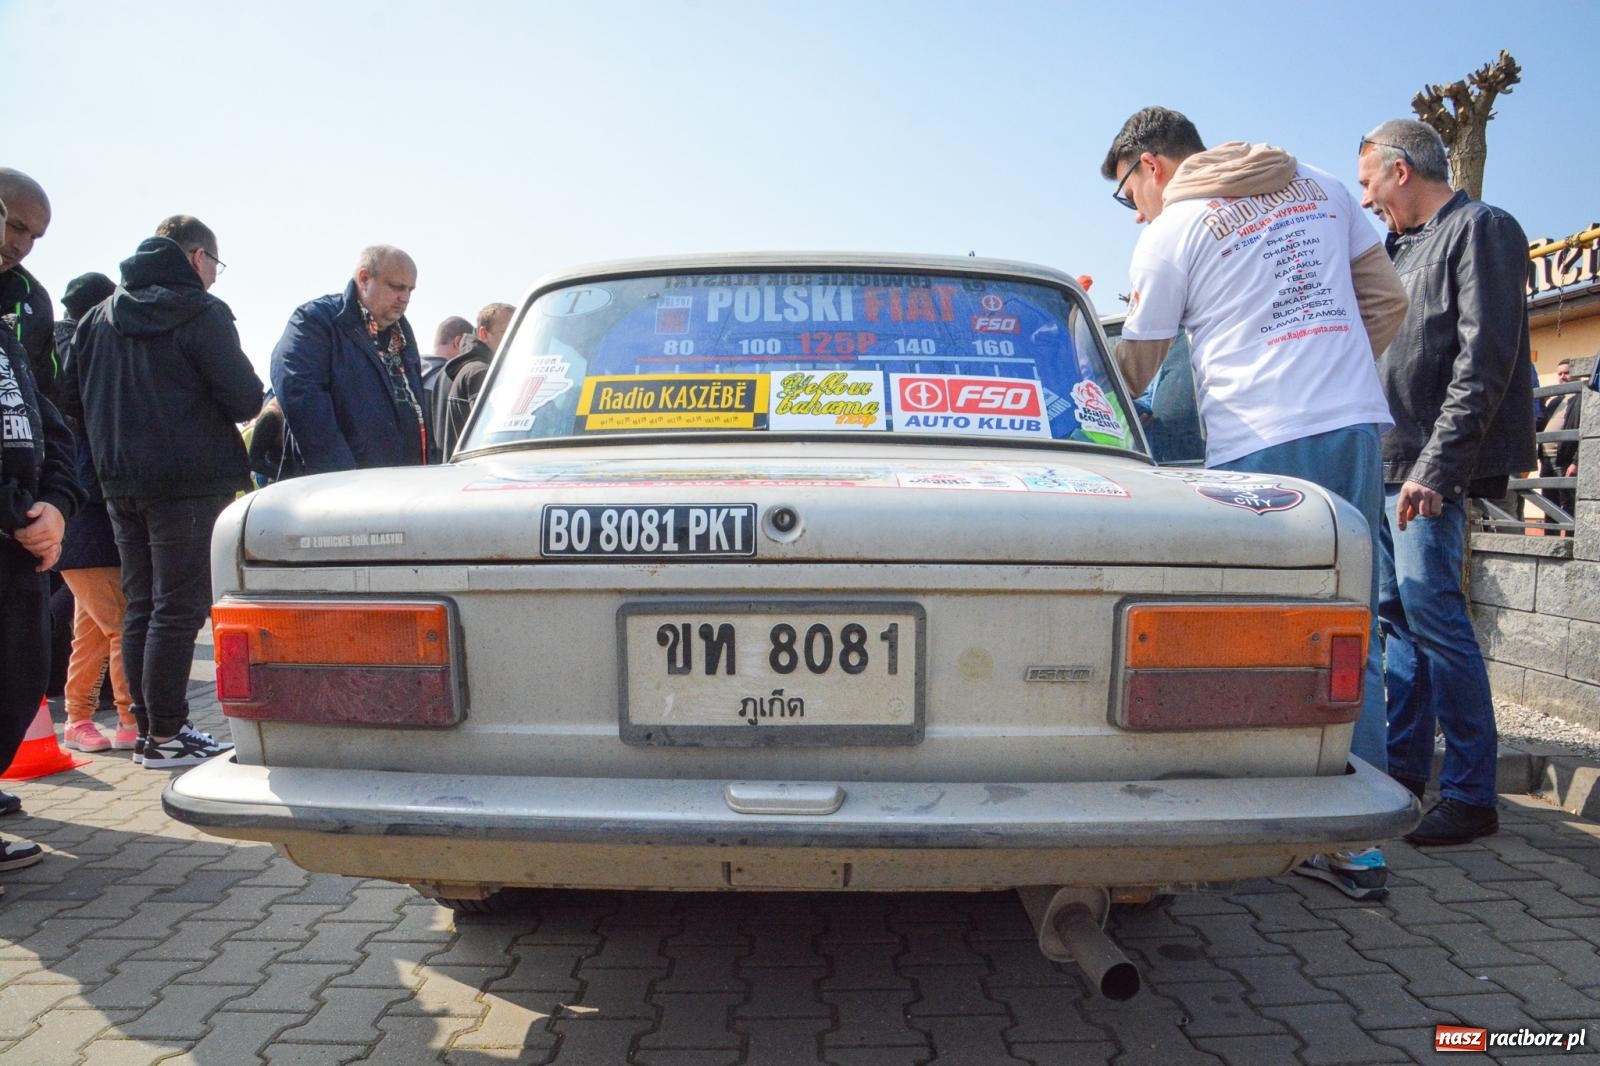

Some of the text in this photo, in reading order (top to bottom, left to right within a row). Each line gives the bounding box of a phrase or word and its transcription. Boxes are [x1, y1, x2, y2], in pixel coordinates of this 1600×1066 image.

[1203, 200, 1259, 241] RAJD
[1264, 219, 1295, 233] AJSKIEJ
[1263, 237, 1320, 260] CHIANG MAI
[1266, 229, 1307, 247] PHUKET
[567, 290, 592, 314] T
[707, 285, 958, 323] POLSKI FIAT
[1272, 288, 1332, 309] BUKARSZT
[1272, 299, 1334, 320] BUDAPESZT
[975, 318, 1017, 331] FSO
[663, 331, 1015, 356] 80 100 125P 140 160
[599, 382, 747, 410] Radio KASZËBË
[956, 385, 1031, 410] FSO
[905, 415, 1041, 431] AUTO KLUB
[1234, 497, 1271, 507] CITY
[551, 508, 748, 552] BO 8081 PKT
[769, 623, 899, 675] 8081
[739, 688, 805, 725] ภูเก็ต
